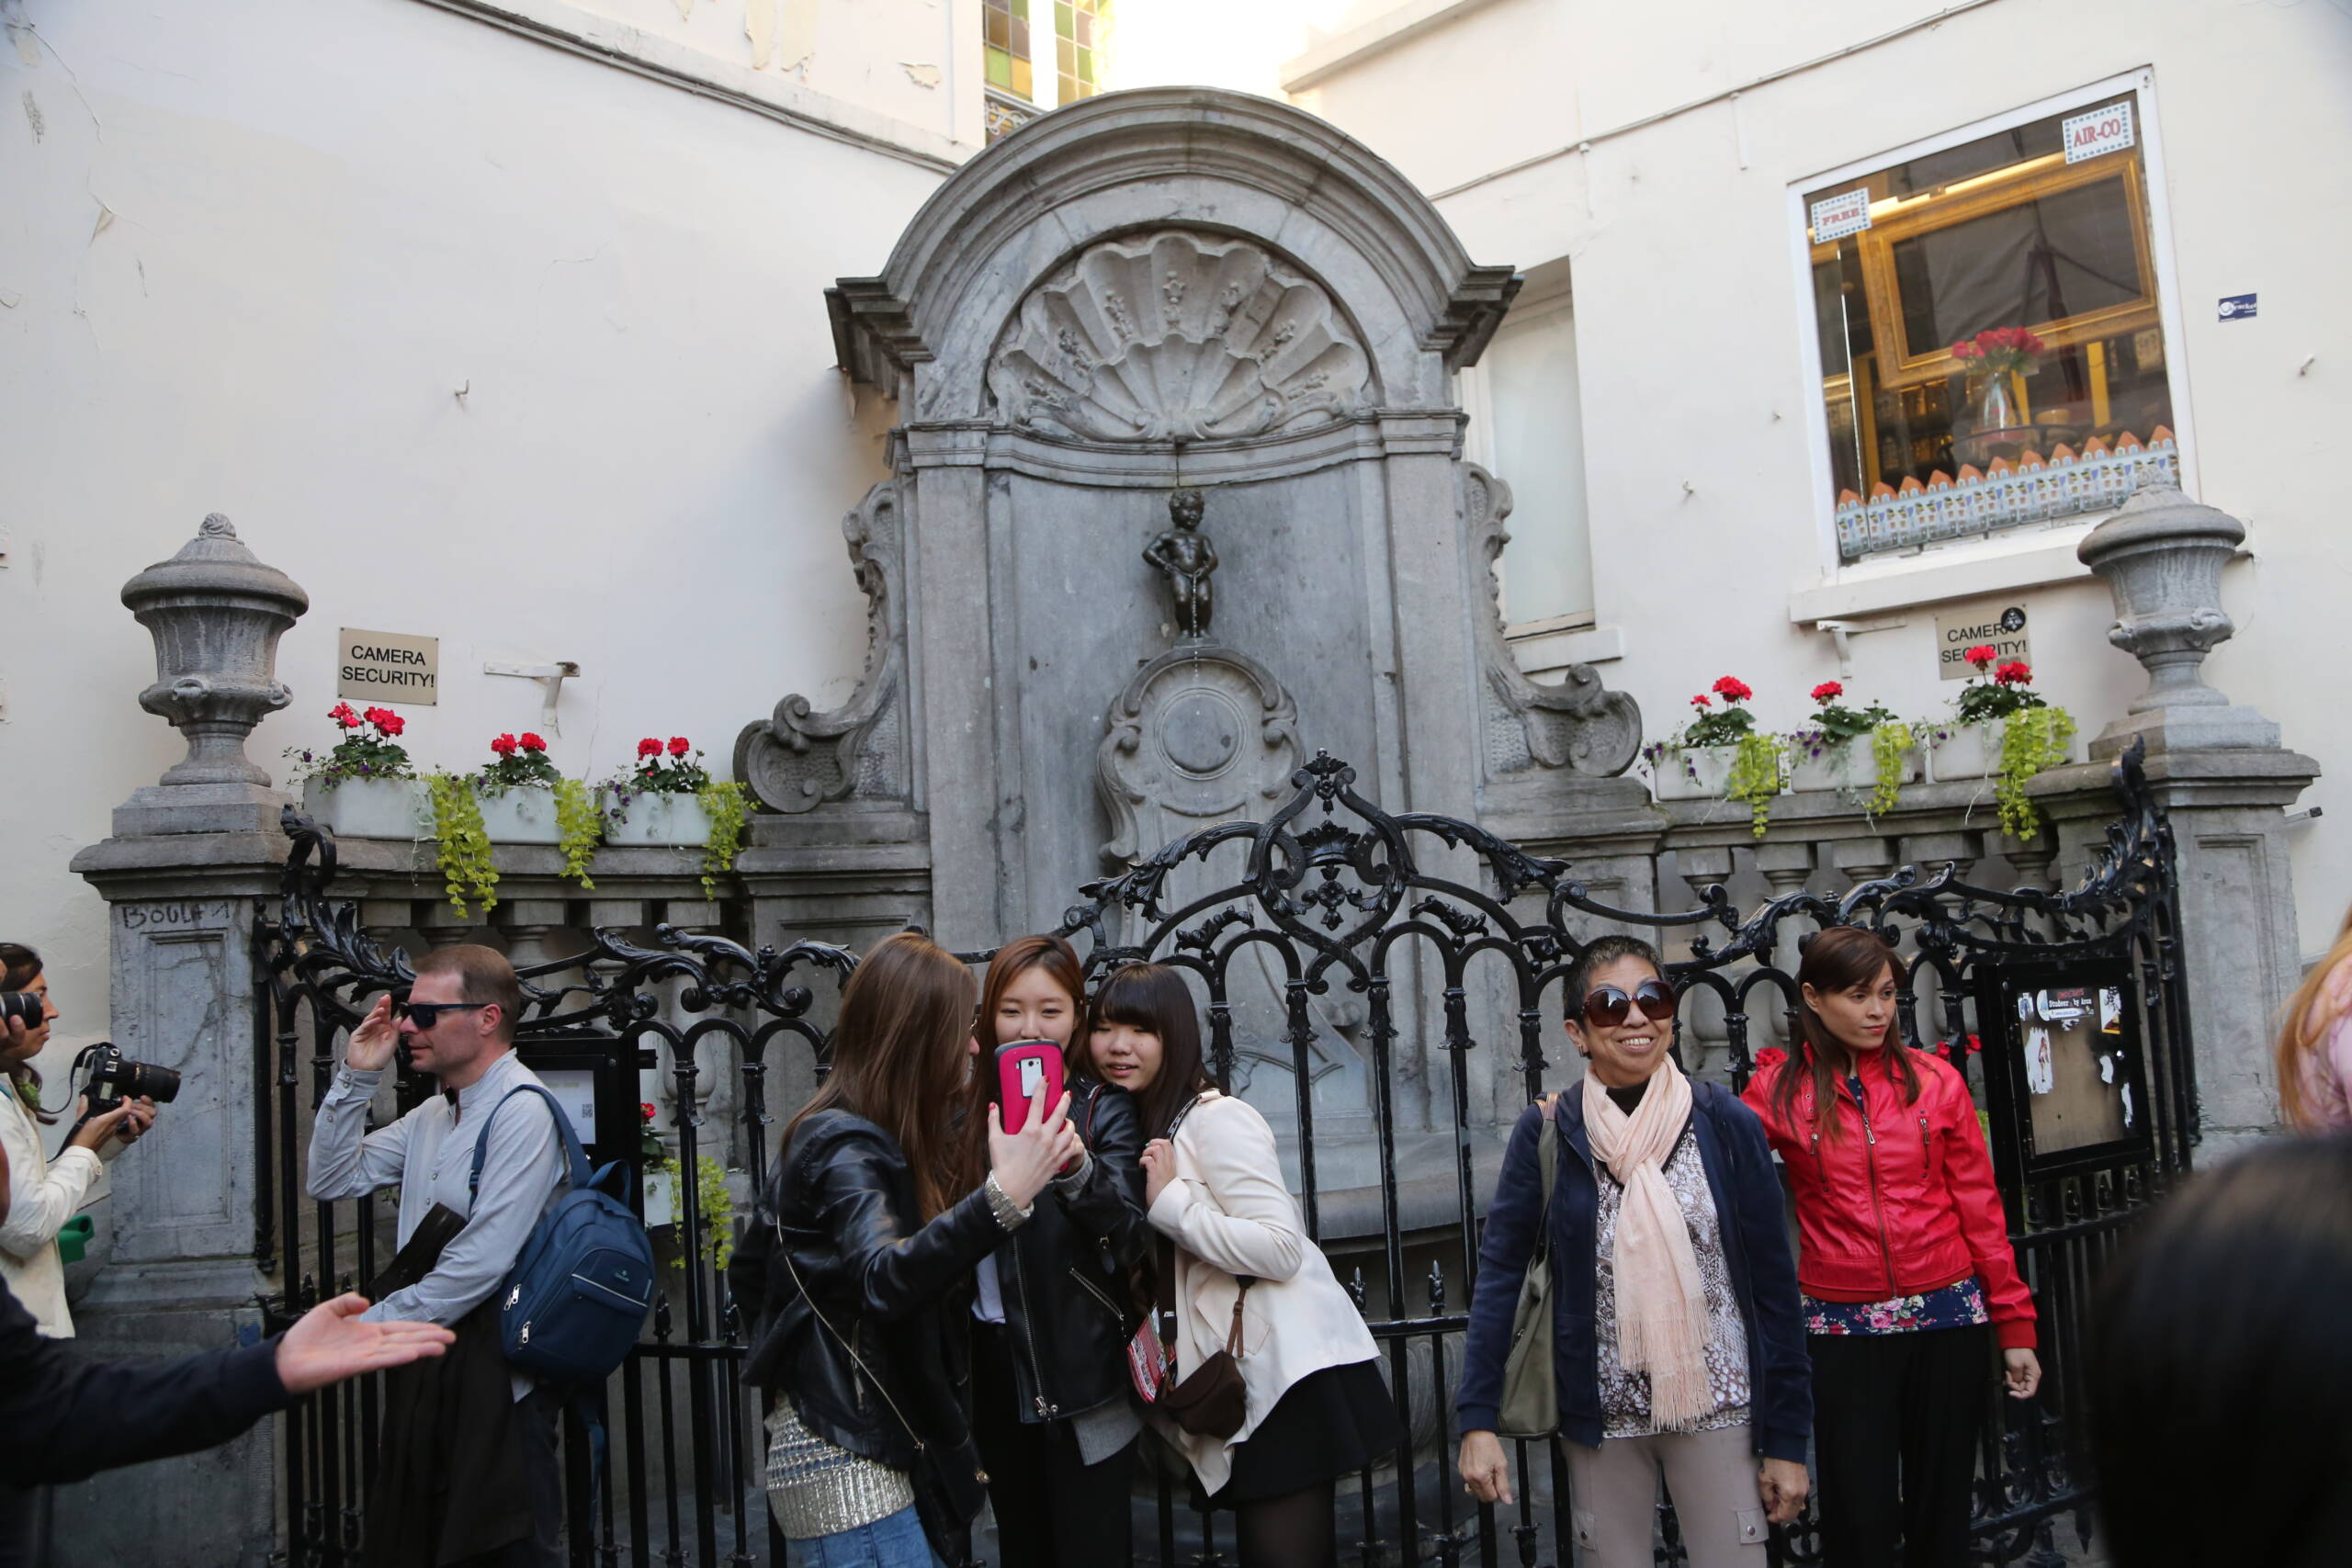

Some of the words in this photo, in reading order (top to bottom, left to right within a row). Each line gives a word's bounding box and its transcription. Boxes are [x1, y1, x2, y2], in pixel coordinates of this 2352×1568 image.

[2073, 118, 2121, 147] AIR-CO
[1822, 208, 1860, 226] FREE
[1947, 622, 2017, 642] CAMER
[351, 645, 426, 667] CAMERA
[341, 665, 435, 688] SECURITY!
